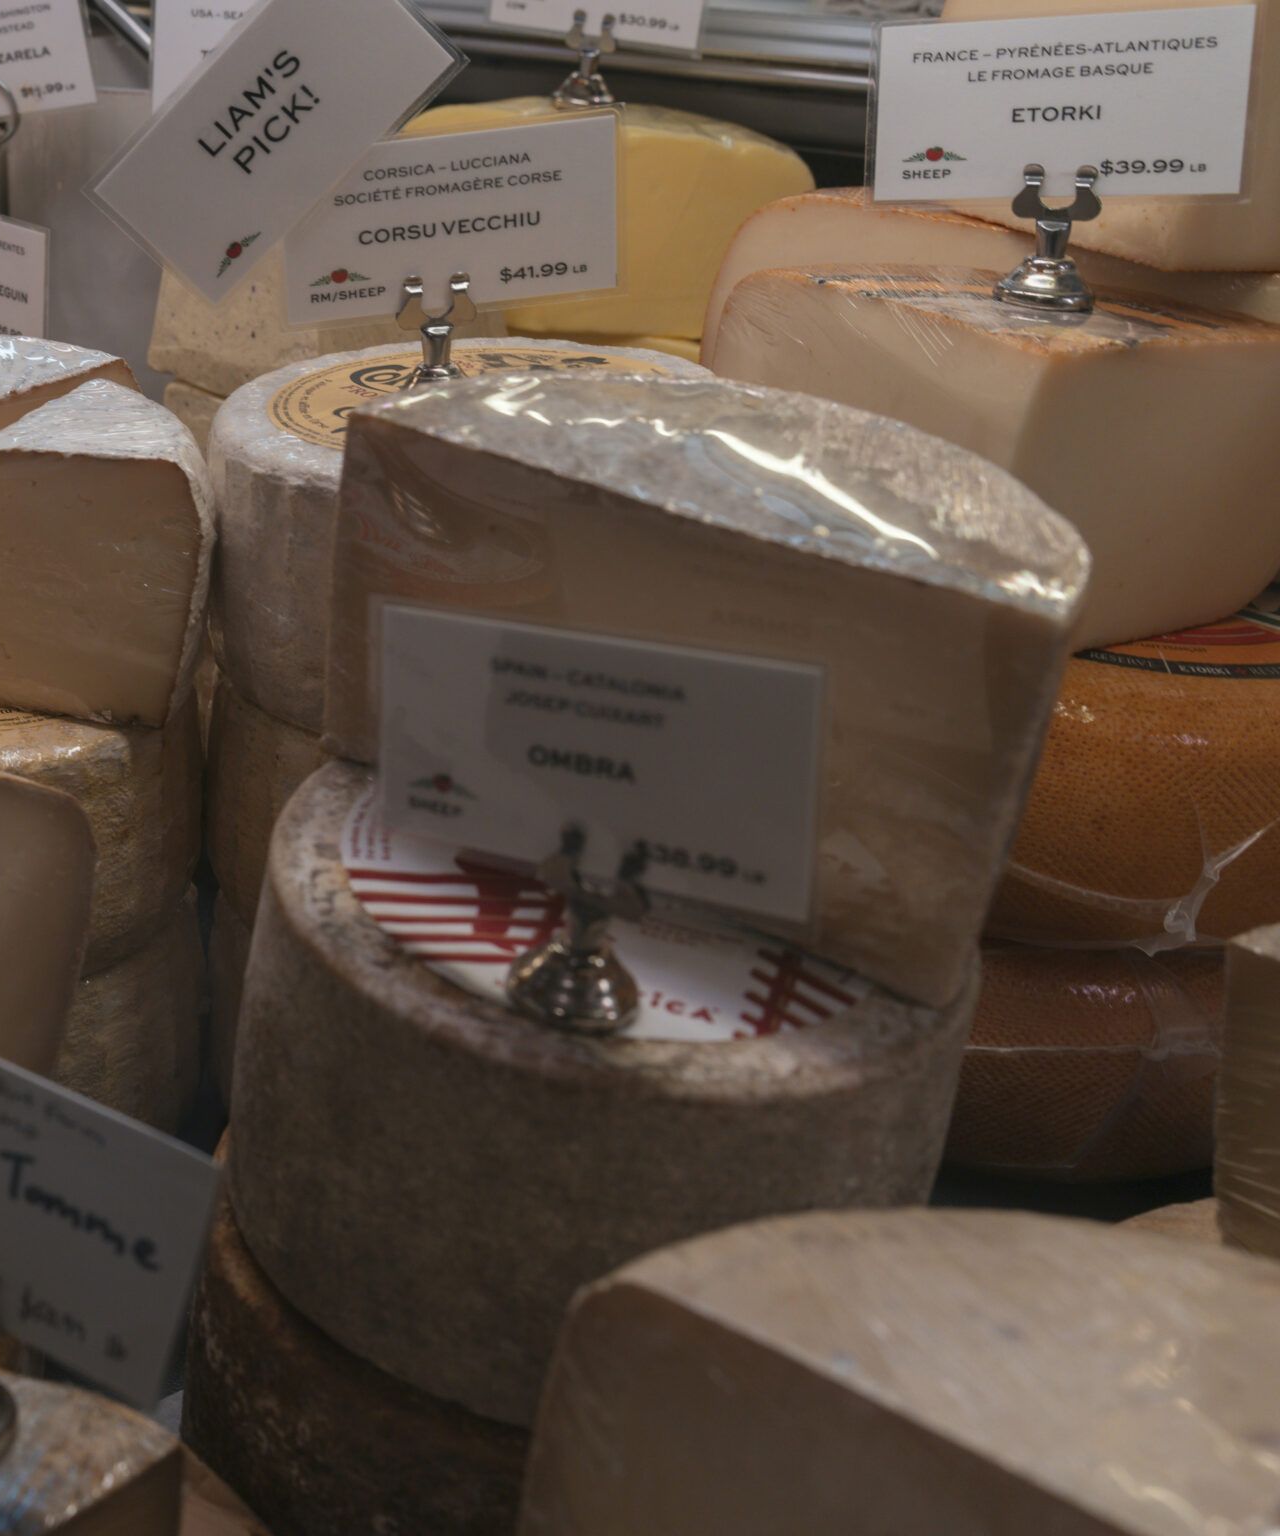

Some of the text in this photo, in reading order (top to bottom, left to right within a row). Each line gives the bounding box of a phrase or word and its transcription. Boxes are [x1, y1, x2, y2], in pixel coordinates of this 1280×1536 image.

[191, 9, 213, 19] USA
[619, 13, 667, 31] $30.99
[912, 35, 1219, 65] FRANCE PYRÉNÉES-ATLANTIQUES
[967, 61, 1155, 83] LE FROMAGE BASQUE
[197, 50, 300, 157] LIAM'S
[1010, 104, 1103, 125] ETORKI
[232, 84, 320, 174] PICK!
[362, 151, 532, 182] CORSICA LUCCIANA
[901, 167, 953, 181] SHEEP
[1099, 157, 1214, 179] $39.99 LB
[333, 169, 563, 208] SOCIÉTÉ FROMAGÈRE CORSE
[357, 210, 541, 246] CORSU VECCHIU
[499, 260, 601, 285] $41.99 LB
[309, 285, 388, 305] RM/SHEEP
[491, 656, 686, 704] SPAIN CATALONIA
[1178, 663, 1232, 678] ETORKI
[526, 743, 638, 786] OMBRA
[0, 1149, 161, 1273] Tomme
